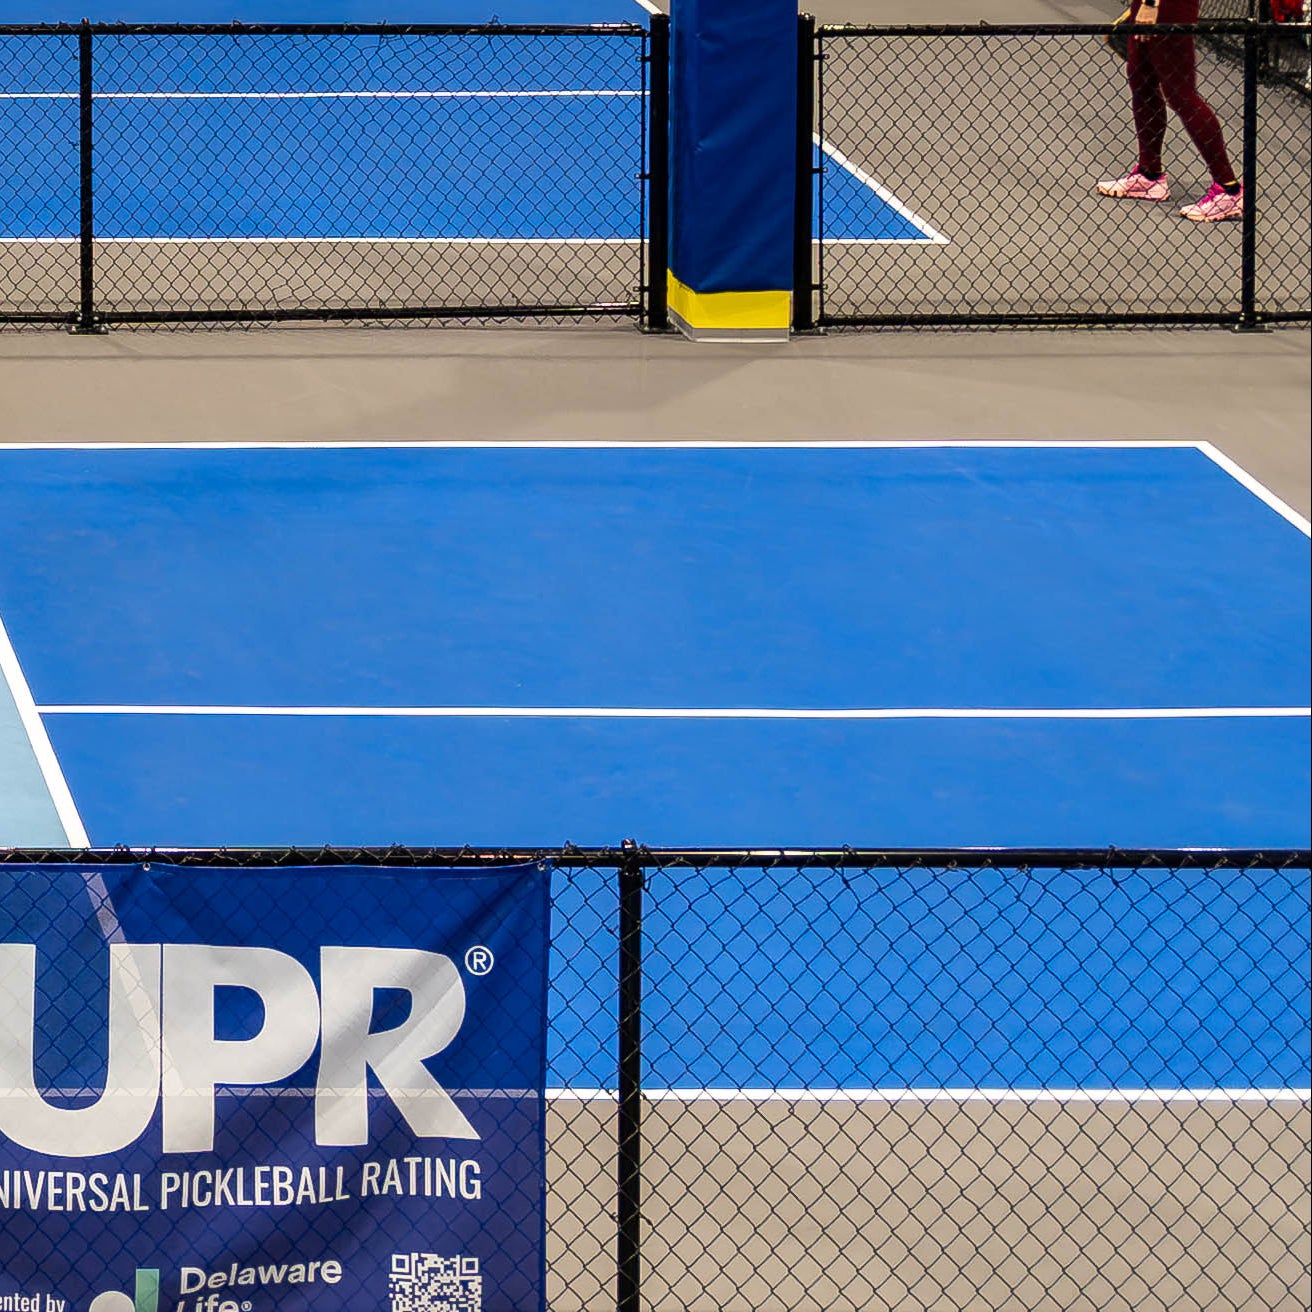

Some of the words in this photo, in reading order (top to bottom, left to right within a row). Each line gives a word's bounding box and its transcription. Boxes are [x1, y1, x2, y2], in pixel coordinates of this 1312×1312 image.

[161, 1166, 350, 1210] PICKLEBALL
[360, 1156, 482, 1199] RATING
[179, 1260, 343, 1295] Delaware
[46, 1292, 66, 1312] by
